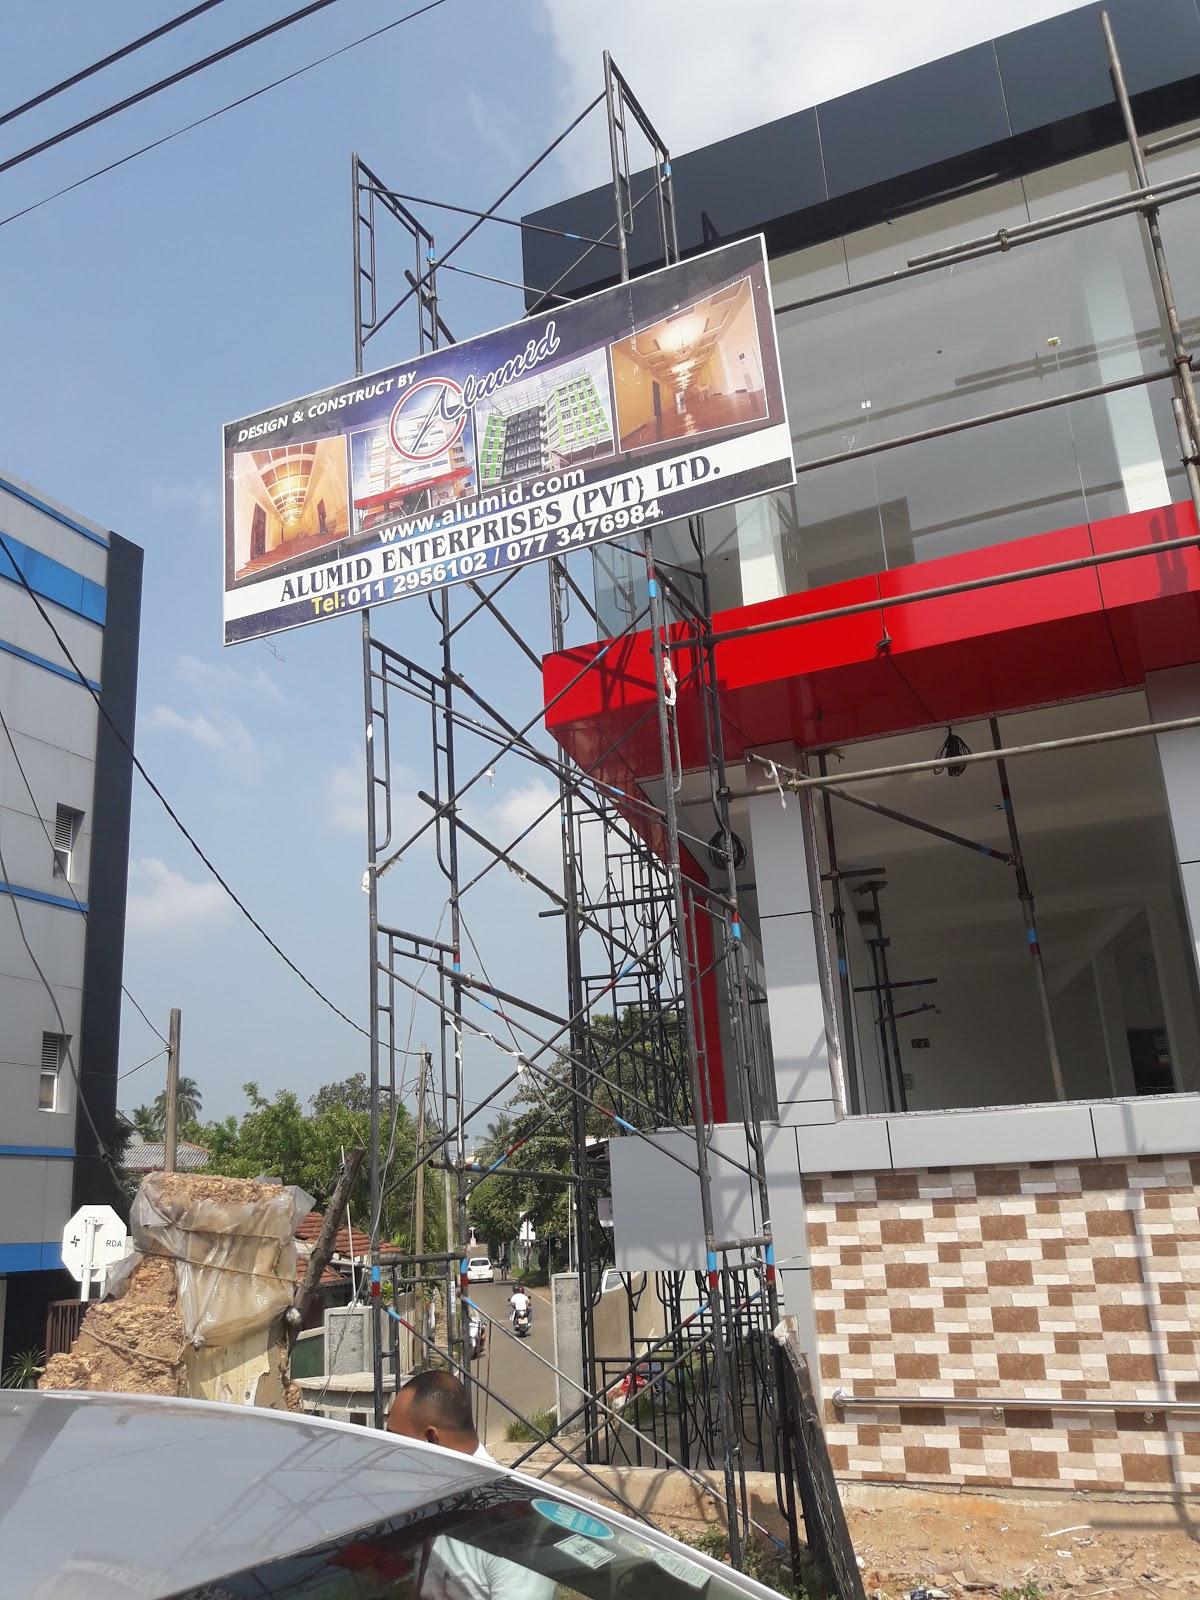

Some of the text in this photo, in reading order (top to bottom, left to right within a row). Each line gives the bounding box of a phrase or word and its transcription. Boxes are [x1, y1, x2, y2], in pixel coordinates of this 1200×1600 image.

[238, 371, 417, 443] DESIGN & CONSTRUCT BY
[409, 321, 561, 455] Alumid
[280, 455, 721, 602] ALUMID ENTERPRISES (PVT) LTD.
[378, 469, 585, 544] www.alumid.com
[393, 552, 488, 594] 2956102
[507, 533, 549, 561] 077
[556, 500, 661, 547] 3476984
[106, 1240, 123, 1248] RDA
